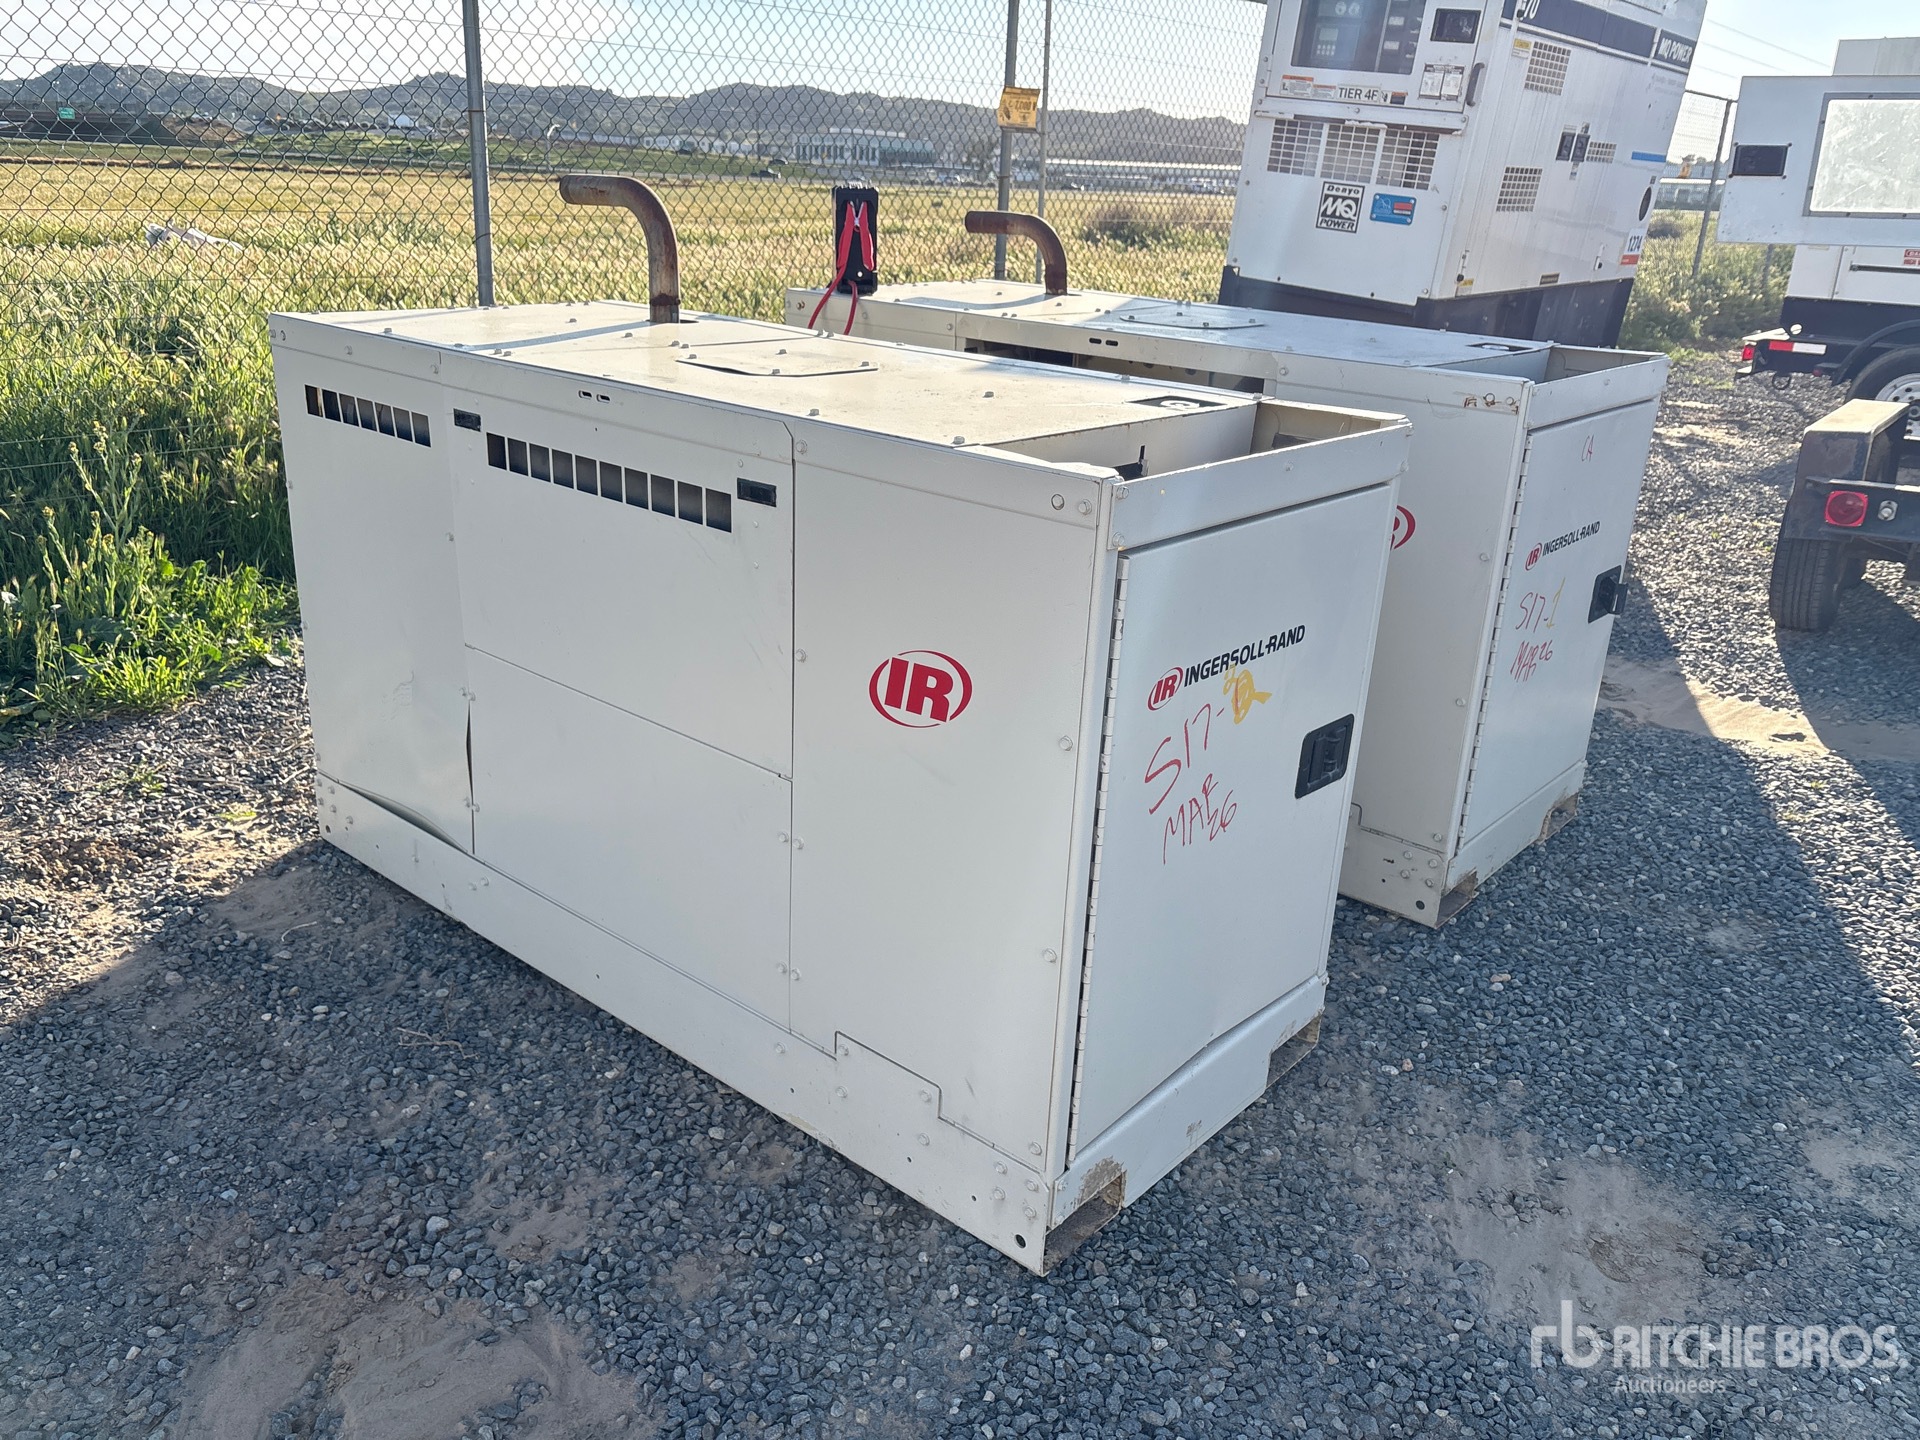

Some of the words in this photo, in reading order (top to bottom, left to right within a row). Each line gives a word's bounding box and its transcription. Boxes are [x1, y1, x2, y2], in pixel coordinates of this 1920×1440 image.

[1669, 41, 1693, 64] POWER
[1338, 87, 1362, 100] TIER
[1364, 89, 1379, 101] 4F
[1326, 184, 1360, 196] Denyo
[1320, 196, 1357, 220] MQ
[1319, 218, 1355, 231] POWER
[1542, 520, 1601, 557] INGERSOLL-RAND
[1184, 624, 1306, 688] INGERSOLL-RAND
[884, 656, 954, 723] IR
